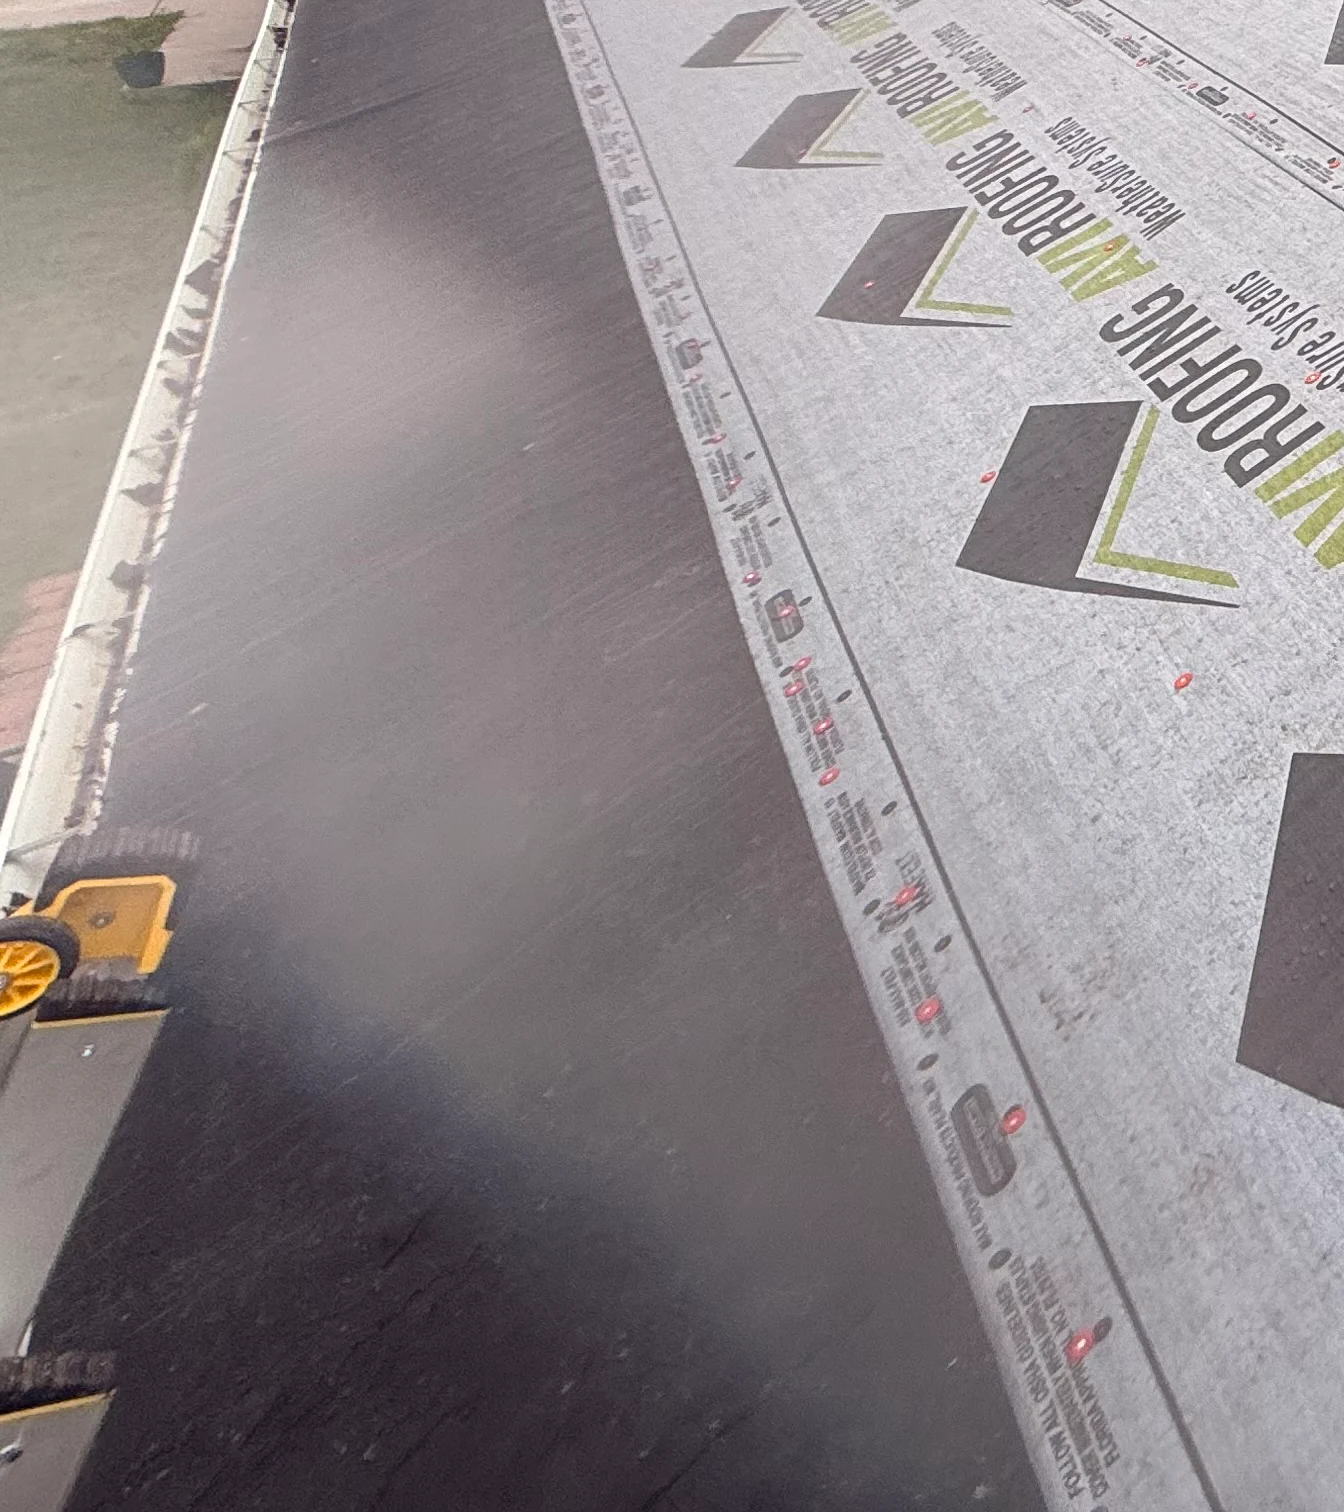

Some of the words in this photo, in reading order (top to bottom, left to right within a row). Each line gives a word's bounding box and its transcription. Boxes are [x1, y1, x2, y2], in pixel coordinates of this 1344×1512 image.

[1085, 153, 1186, 241] WeatherSure
[1225, 269, 1318, 349] Systems
[1039, 1397, 1061, 1435] ALL
[1048, 1428, 1086, 1501] FOLLOW
